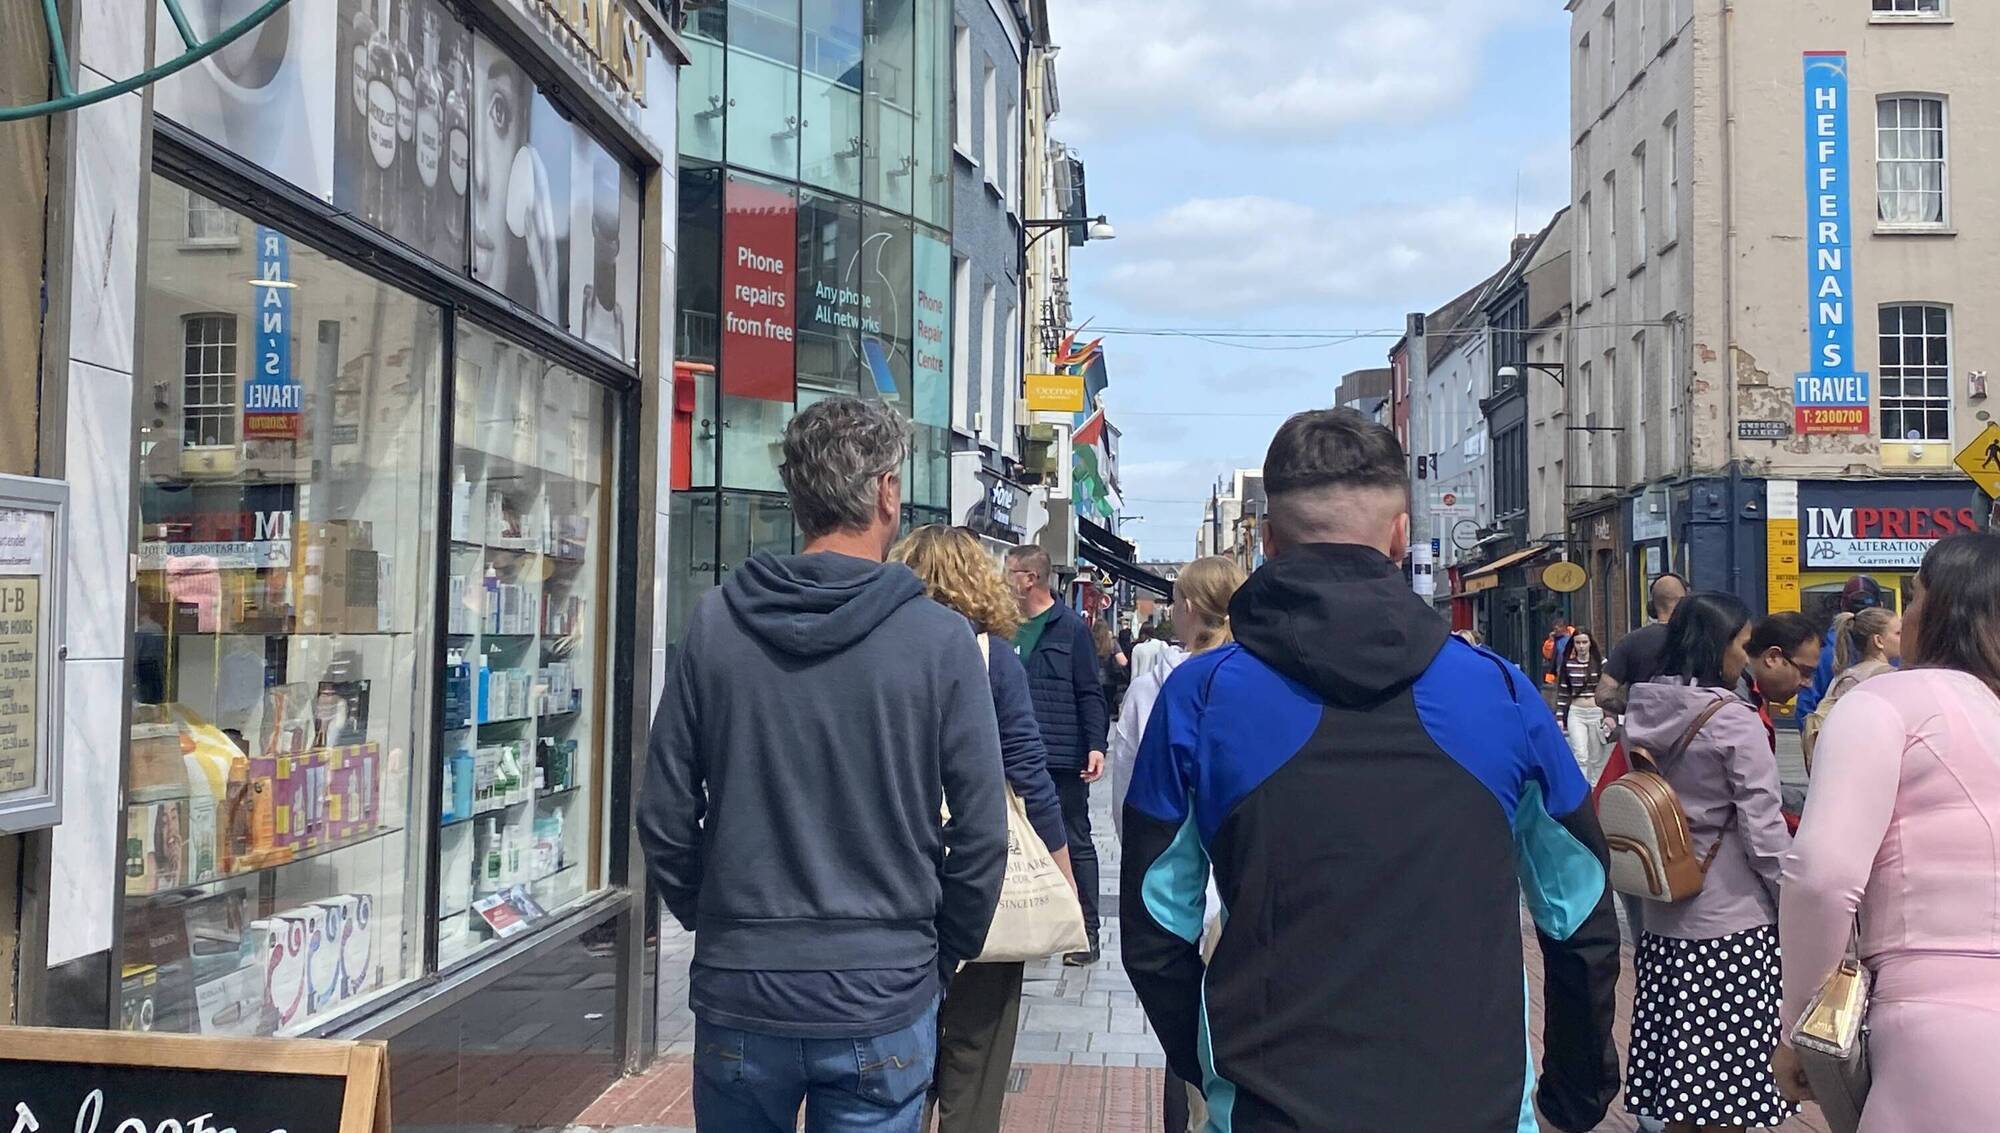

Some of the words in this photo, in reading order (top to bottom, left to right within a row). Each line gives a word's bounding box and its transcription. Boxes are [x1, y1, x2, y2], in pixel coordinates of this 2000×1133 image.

[1815, 87, 1842, 368] HEFFERNAN'S
[738, 246, 784, 275] Phone
[735, 283, 786, 308] repairs
[816, 280, 837, 305] Any
[839, 287, 872, 309] phone
[918, 290, 943, 315] Phone
[726, 311, 762, 337] from
[765, 317, 793, 342] free
[815, 305, 832, 325] All
[834, 311, 880, 333] networks
[918, 319, 943, 343] Repair
[917, 350, 944, 373] Centre
[1797, 377, 1867, 402] TRAVEL
[1803, 410, 1813, 423] T:
[1815, 410, 1863, 424] 2300700
[1806, 507, 1981, 539] IMPRESS
[1858, 555, 1905, 565] Garment
